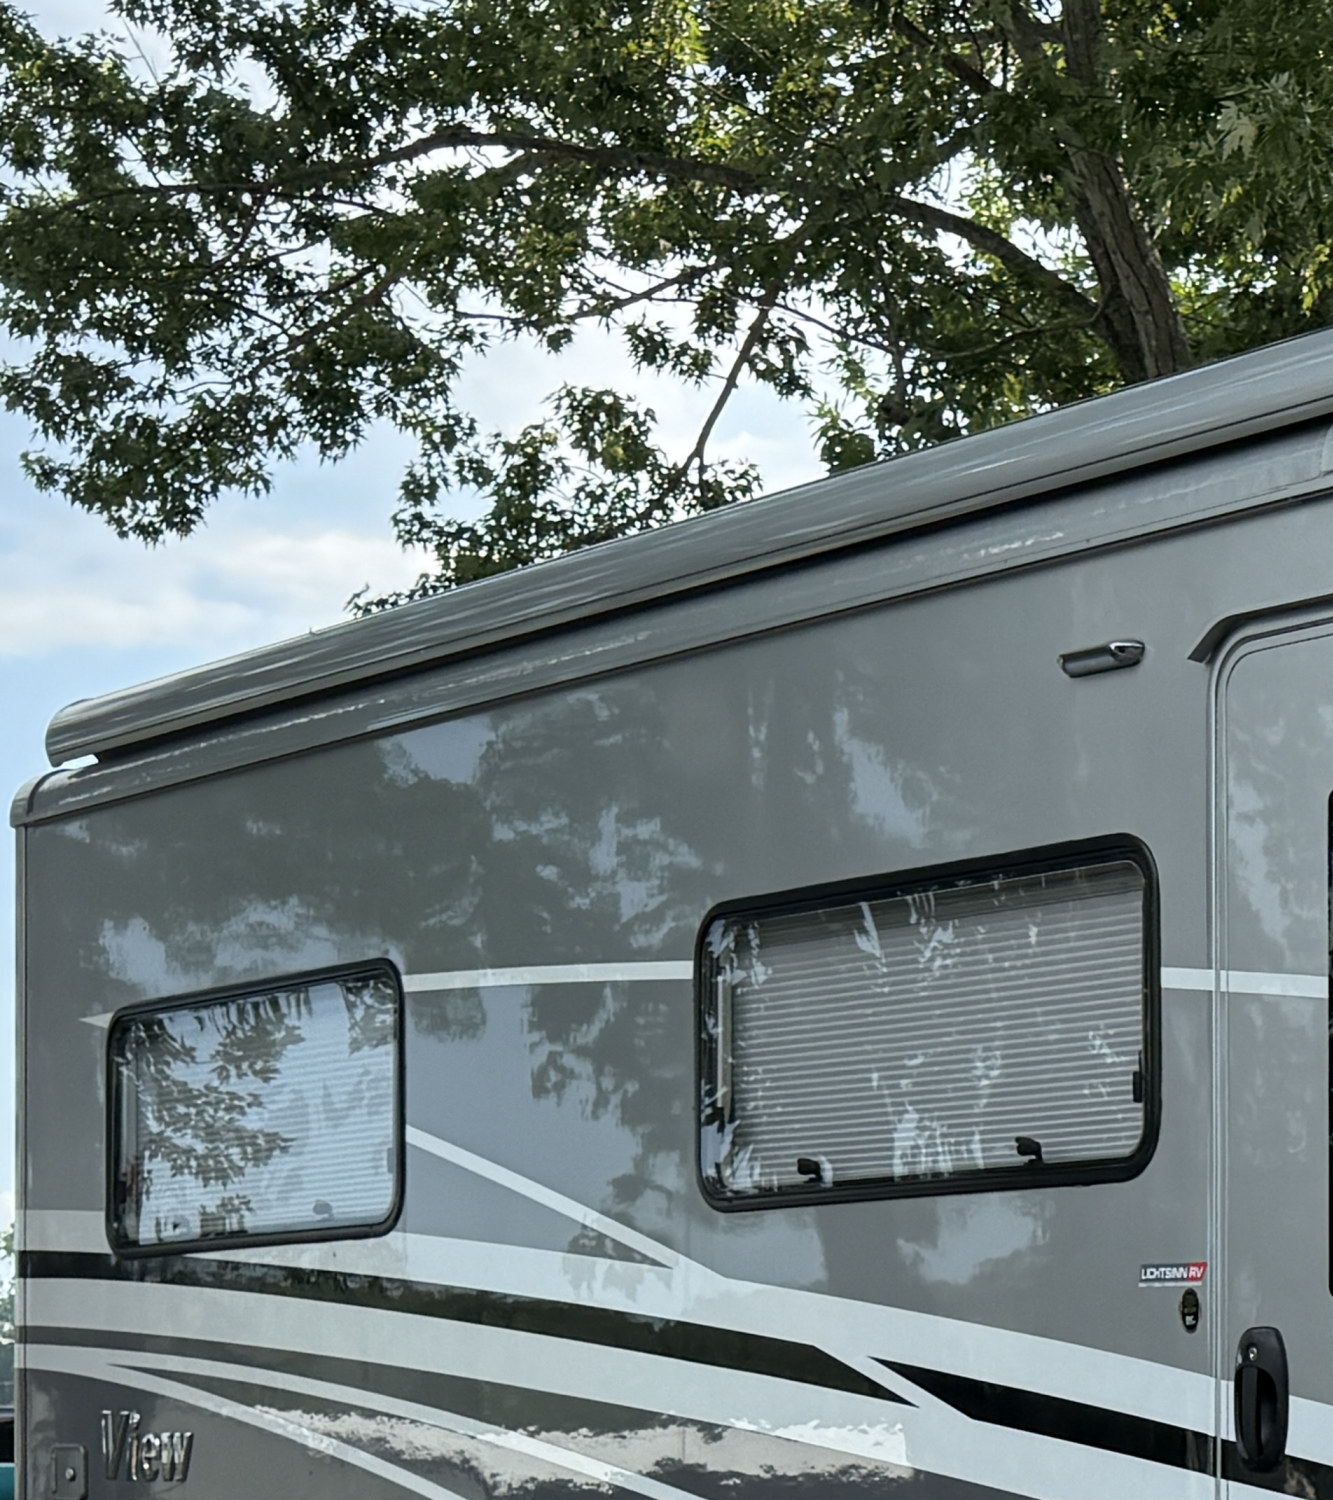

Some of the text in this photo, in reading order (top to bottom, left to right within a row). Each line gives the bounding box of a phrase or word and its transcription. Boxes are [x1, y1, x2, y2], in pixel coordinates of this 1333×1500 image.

[1141, 1265, 1204, 1280] LICHTSINN RV
[100, 1409, 194, 1483] View
